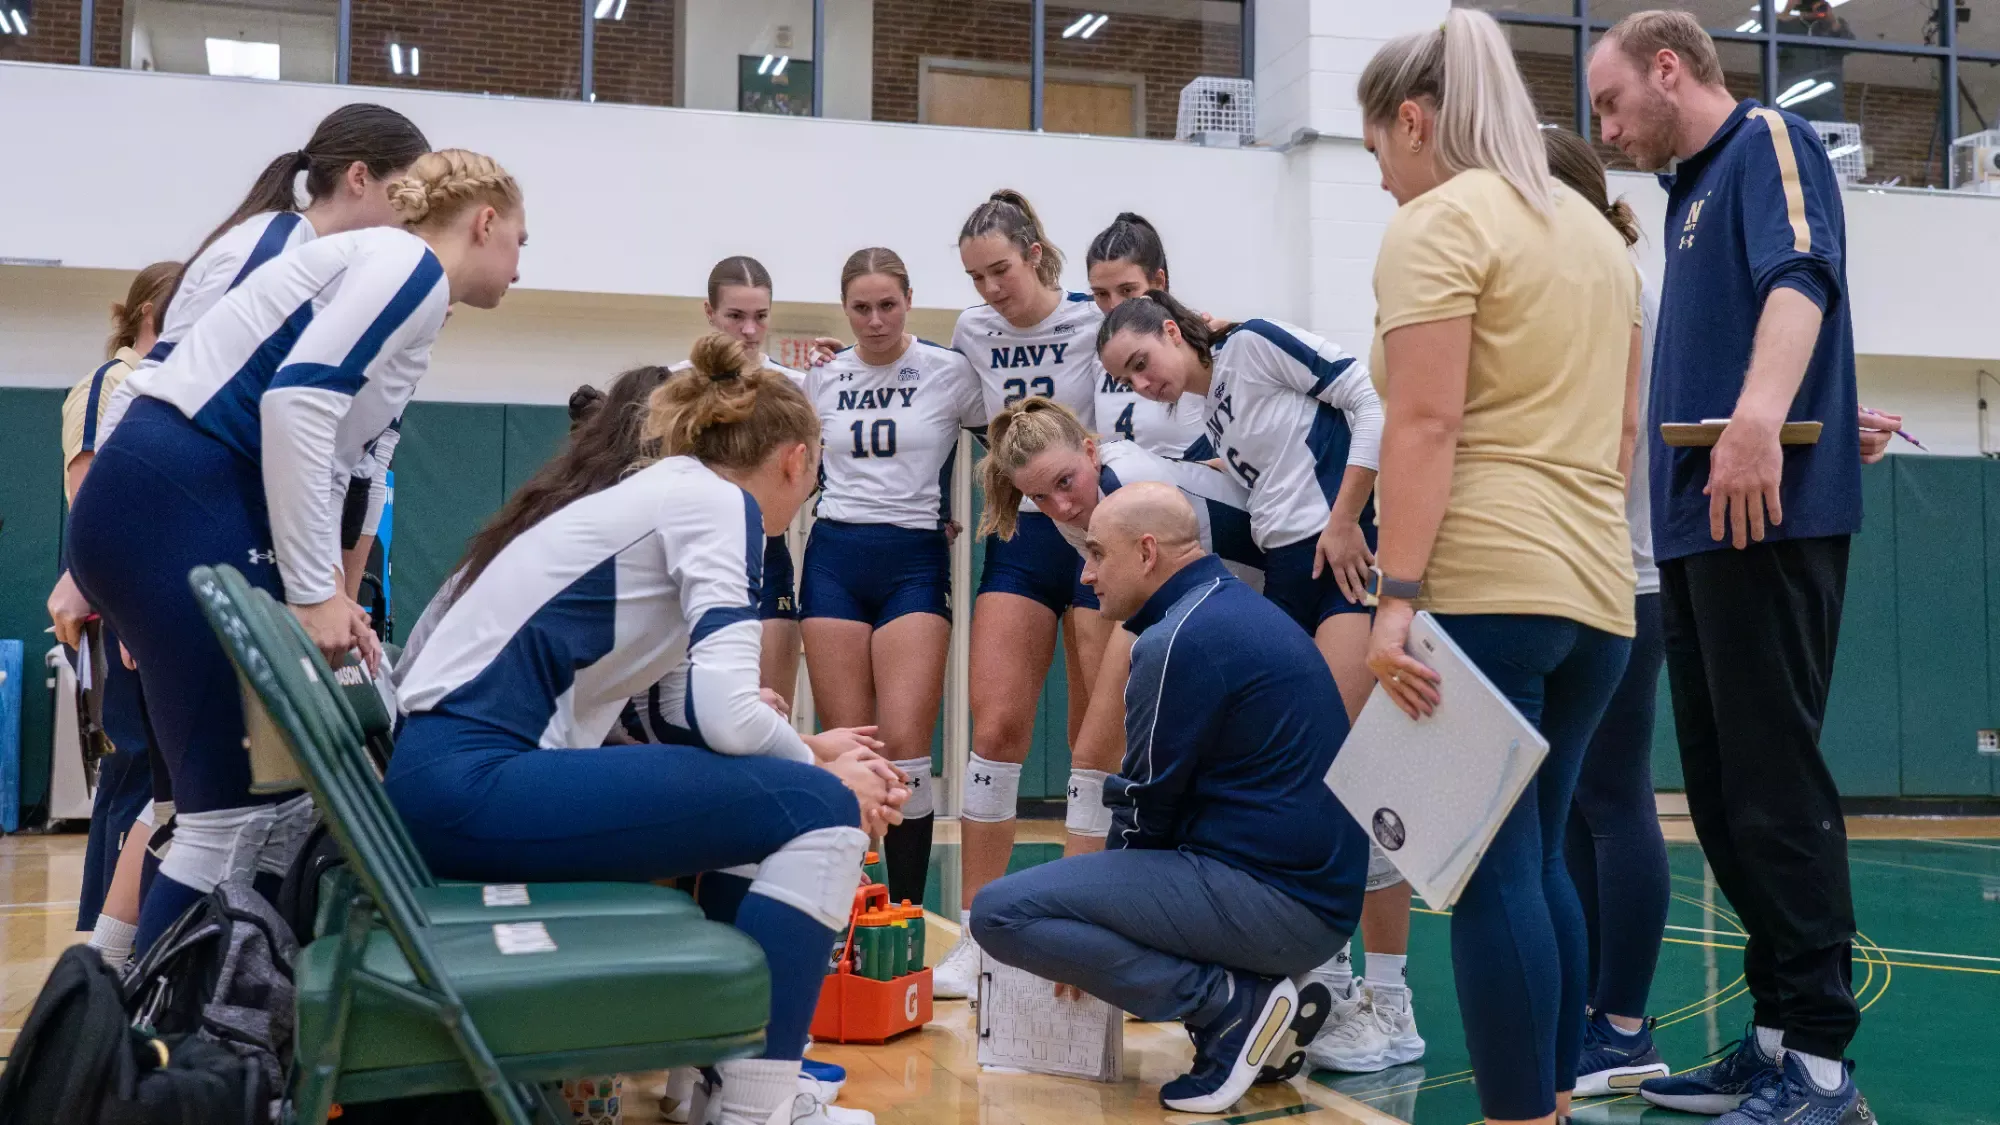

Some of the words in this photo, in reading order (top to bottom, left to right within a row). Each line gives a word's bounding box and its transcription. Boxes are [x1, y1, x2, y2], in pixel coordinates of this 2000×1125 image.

[1685, 199, 1705, 225] N
[990, 343, 1069, 369] NAVY
[836, 387, 918, 411] NAVY
[850, 419, 897, 459] 10
[1115, 402, 1136, 442] 4
[1206, 394, 1235, 452] AVY
[1227, 446, 1261, 489] 6
[777, 596, 792, 611] N
[905, 983, 918, 1022] G
